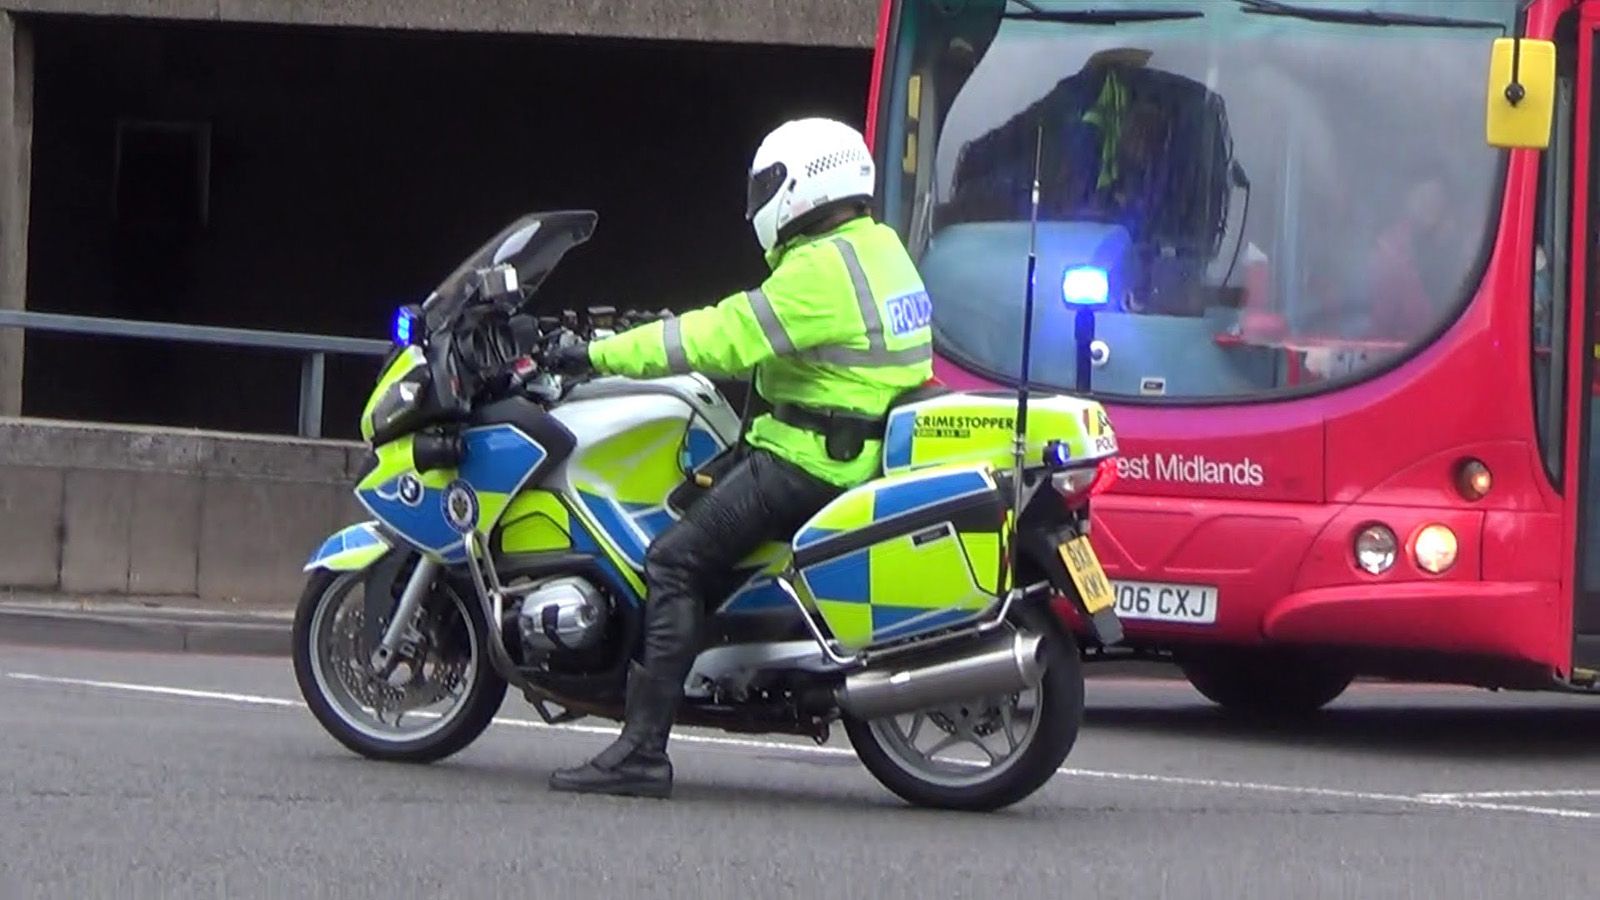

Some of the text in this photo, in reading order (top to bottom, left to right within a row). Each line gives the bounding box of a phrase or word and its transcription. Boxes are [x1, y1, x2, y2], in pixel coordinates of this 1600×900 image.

[915, 415, 1015, 430] CRIMESTOPPER
[1116, 453, 1264, 486] est Midlands
[1114, 584, 1207, 617] 06 CXJ
